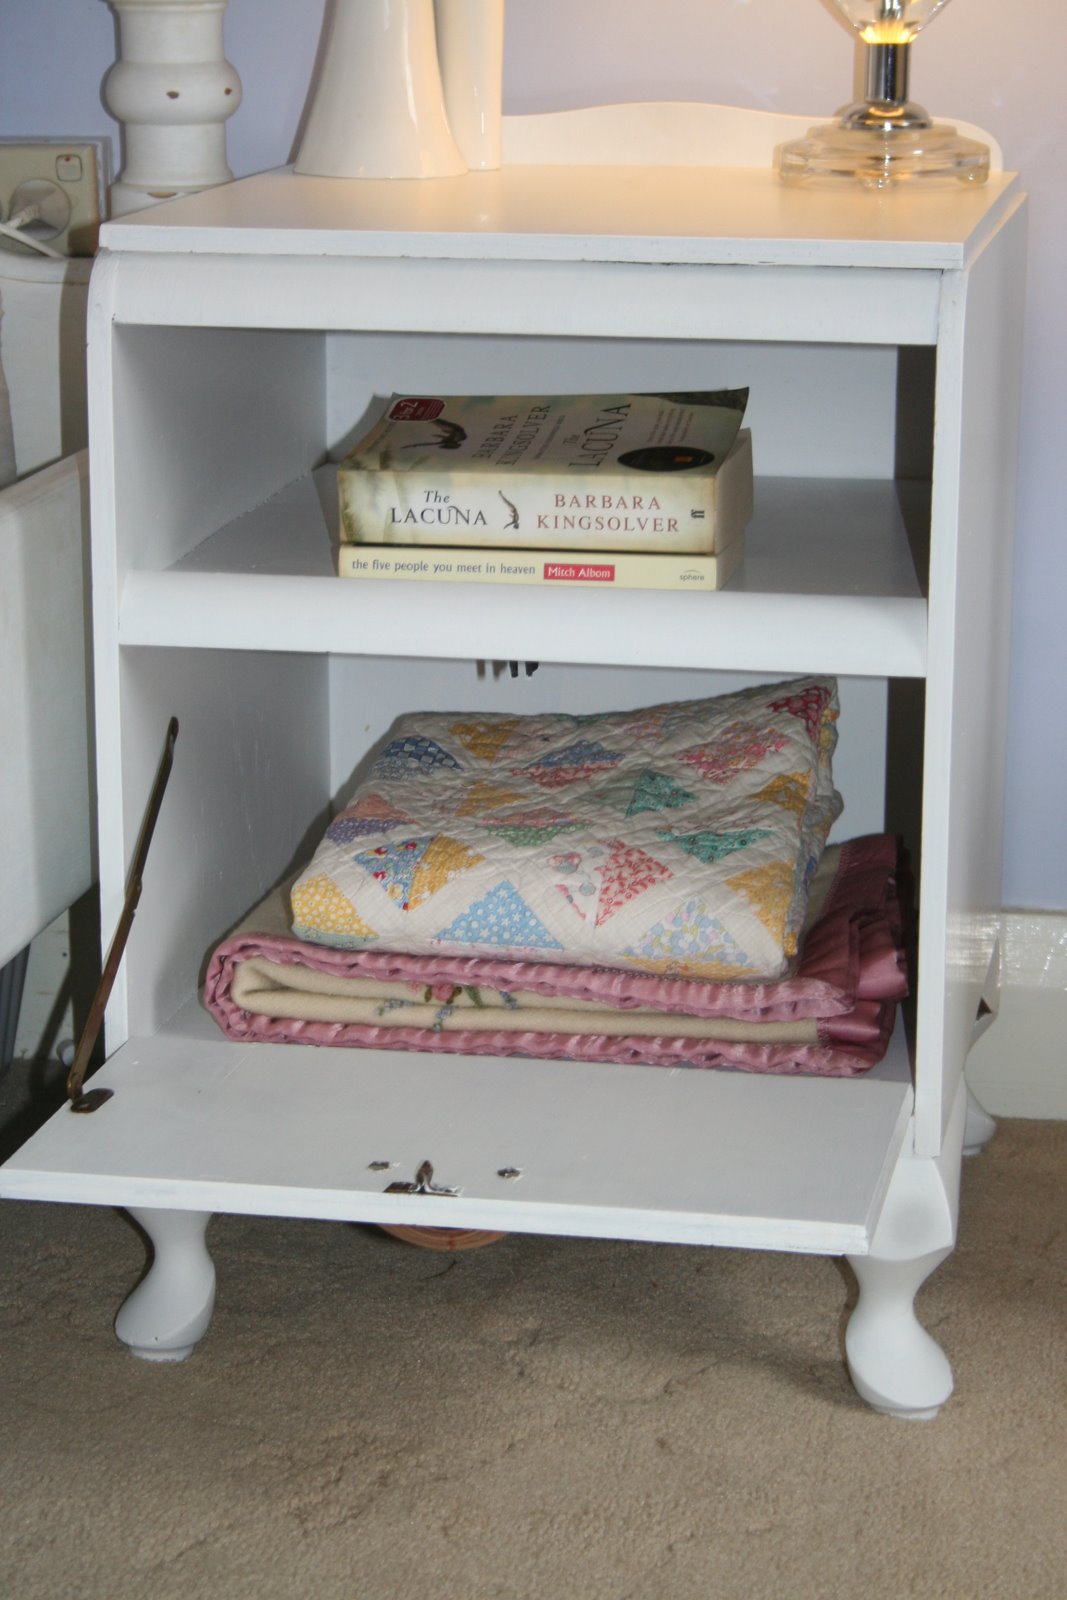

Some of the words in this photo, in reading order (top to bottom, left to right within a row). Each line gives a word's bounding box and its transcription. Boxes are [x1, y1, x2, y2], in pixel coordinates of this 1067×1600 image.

[569, 403, 632, 467] LACUNA
[424, 490, 450, 504] The
[554, 494, 661, 510] BARBARA
[390, 505, 487, 526] LACUNA
[537, 514, 679, 532] KINGSOLVER
[352, 559, 368, 570] the
[372, 559, 390, 570] five
[394, 560, 429, 574] people
[433, 562, 452, 574] you
[456, 563, 482, 573] meet
[485, 562, 496, 574] in
[500, 562, 536, 575] heaven
[547, 566, 576, 577] Mitch
[578, 567, 611, 578] Albom
[679, 573, 705, 582] sphere
